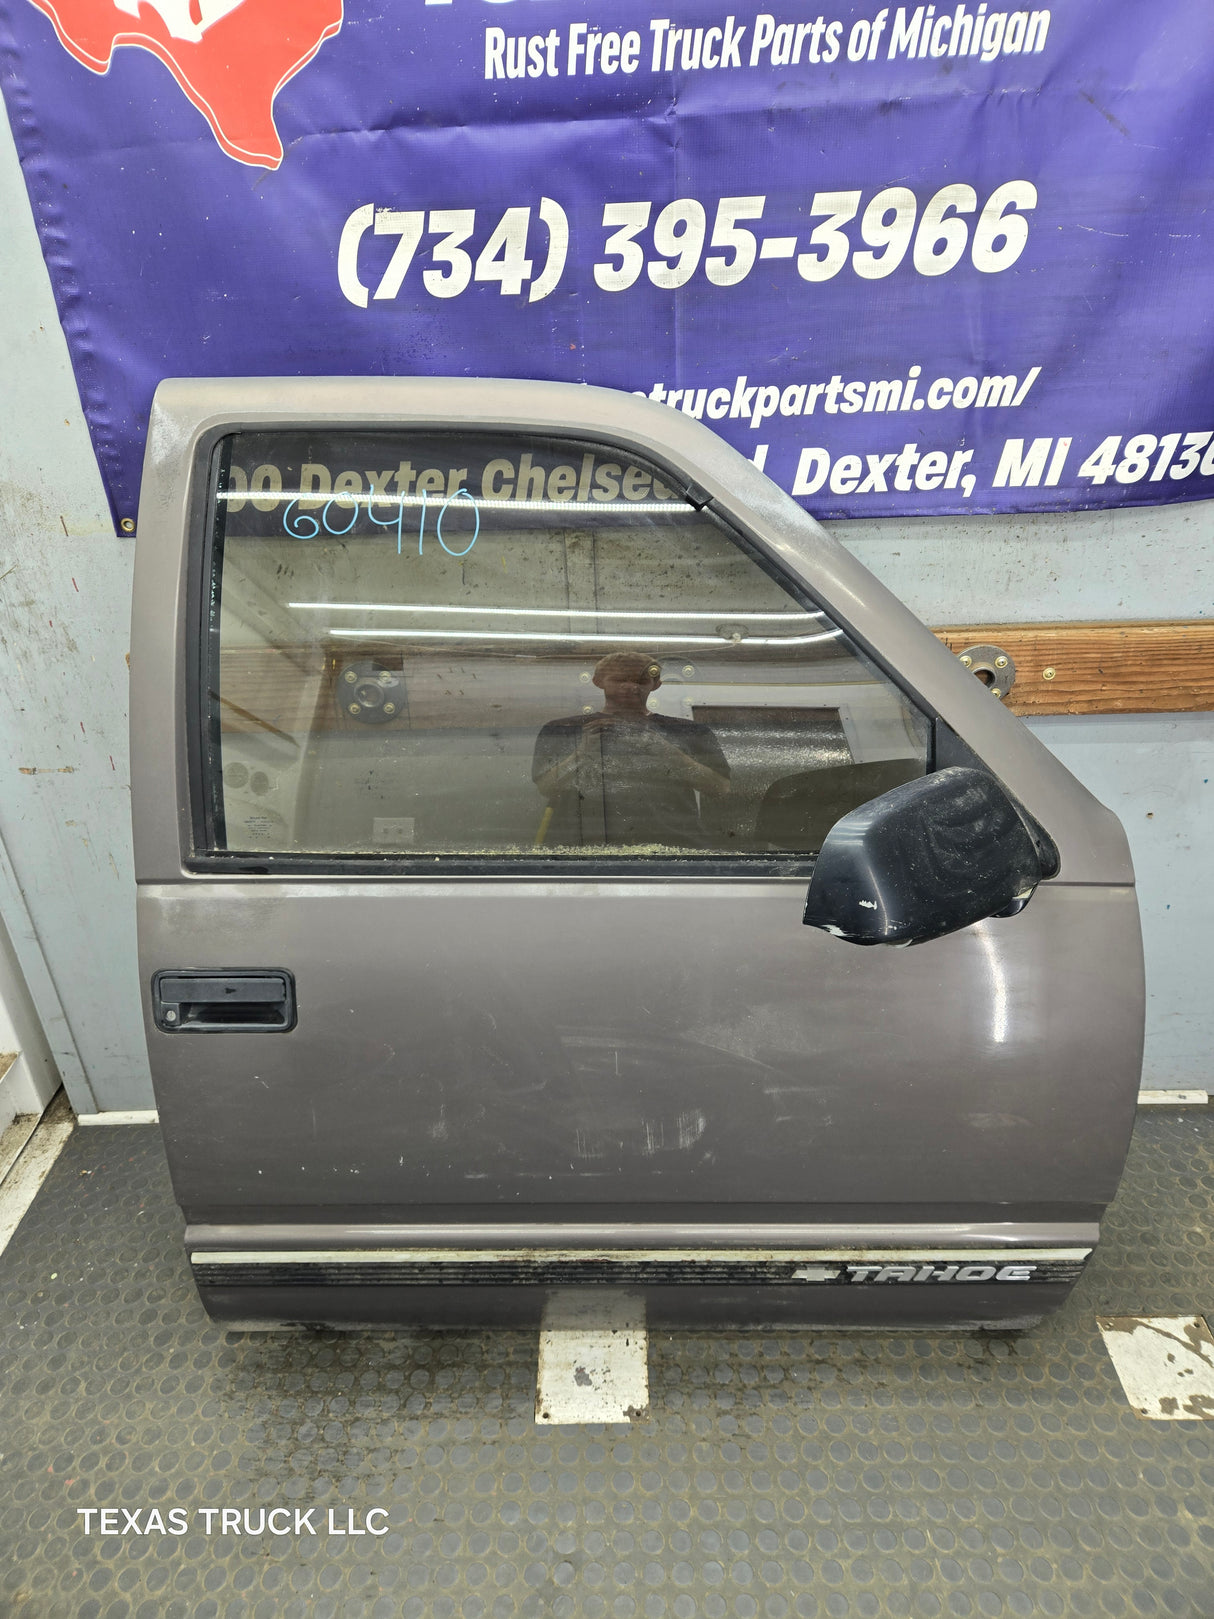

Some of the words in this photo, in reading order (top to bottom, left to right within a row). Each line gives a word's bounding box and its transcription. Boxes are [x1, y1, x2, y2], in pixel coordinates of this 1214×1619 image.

[485, 27, 560, 80] Rust
[567, 23, 641, 76] Free
[650, 16, 746, 72] Truck
[750, 14, 843, 66] Parts
[847, 8, 889, 61] of
[887, 3, 1051, 62] Michigan
[337, 196, 570, 309] (734)
[593, 180, 1037, 292] 395-3966
[631, 366, 1041, 428] truckpartsmi.com/
[298, 460, 469, 511] Dexter
[791, 445, 975, 497] Dexter,
[992, 437, 1073, 488] MI
[282, 484, 481, 556] 60410
[847, 1265, 1038, 1282] TAHOE
